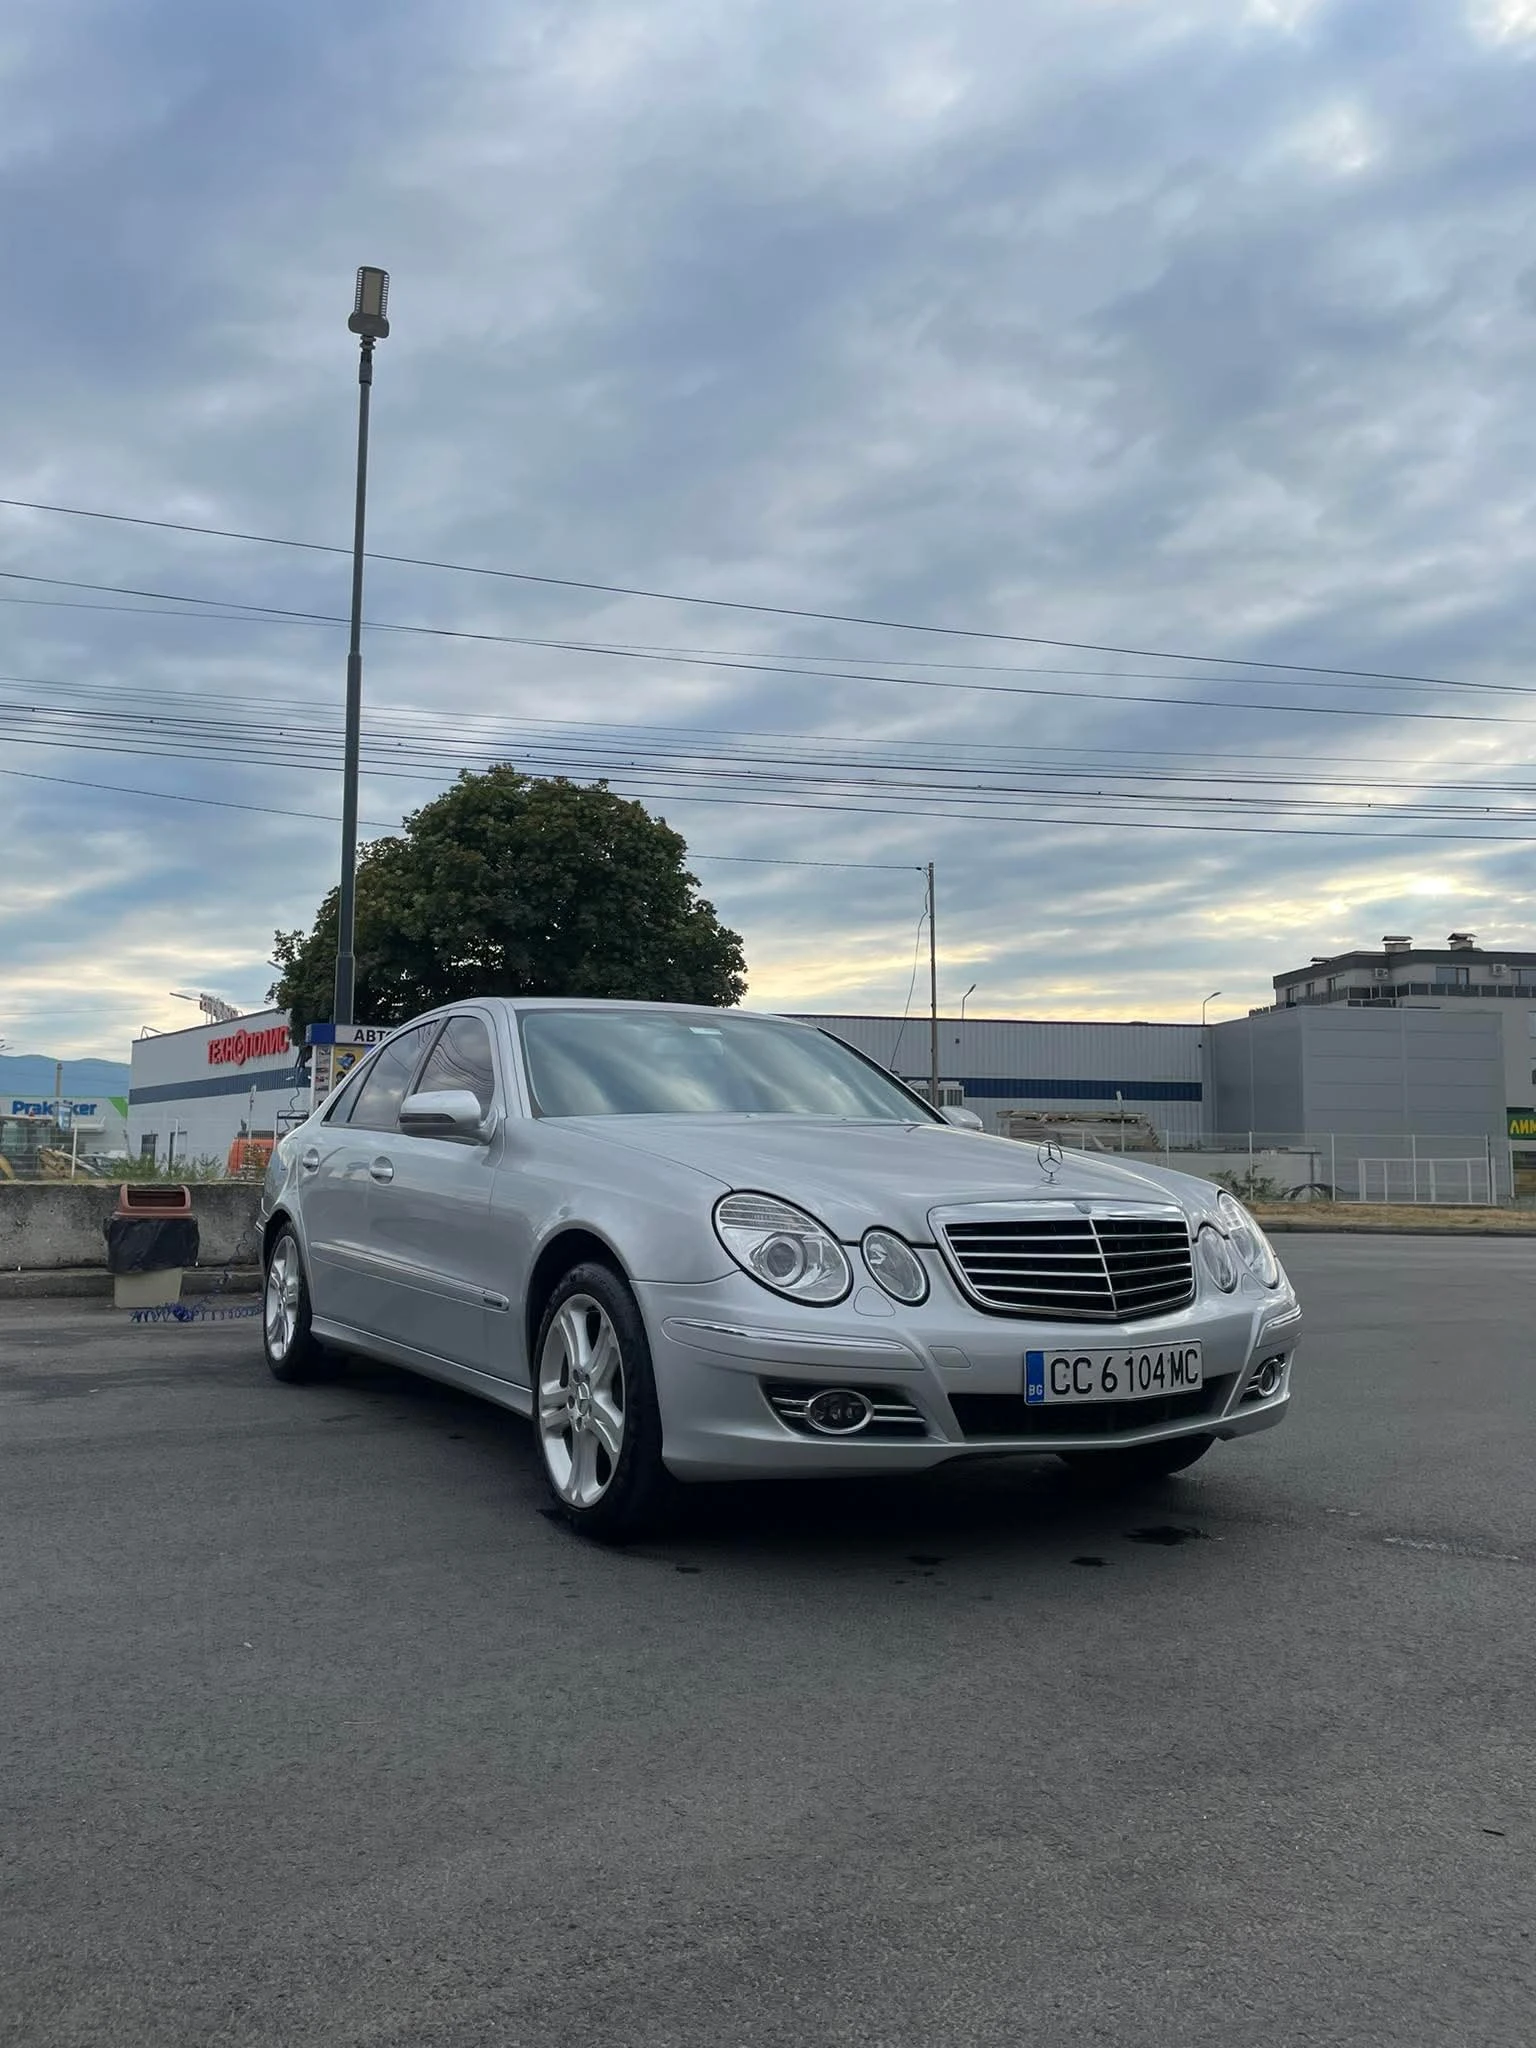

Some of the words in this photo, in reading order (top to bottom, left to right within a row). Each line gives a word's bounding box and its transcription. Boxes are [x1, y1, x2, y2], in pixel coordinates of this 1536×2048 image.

[353, 1029, 393, 1042] АВТ
[207, 1026, 290, 1066] ТЕХНОПОЛИС
[1028, 1384, 1043, 1397] BG
